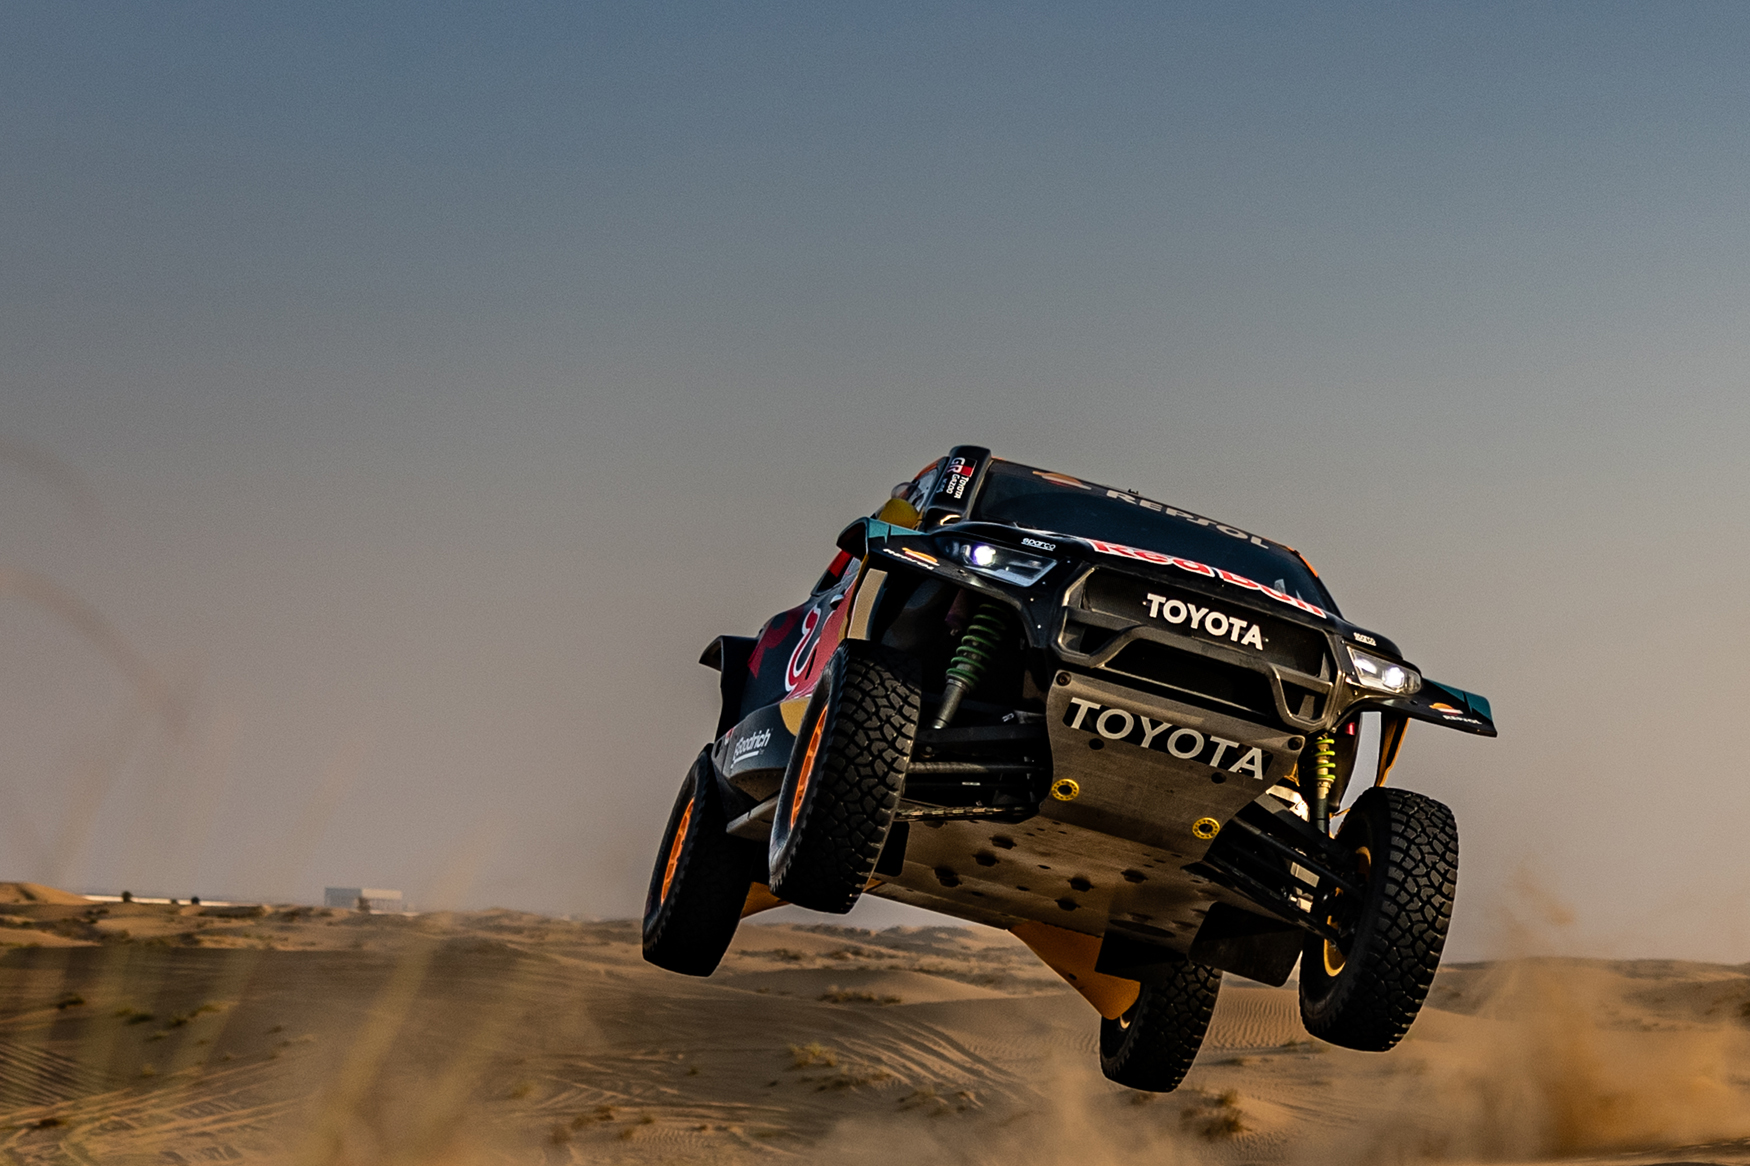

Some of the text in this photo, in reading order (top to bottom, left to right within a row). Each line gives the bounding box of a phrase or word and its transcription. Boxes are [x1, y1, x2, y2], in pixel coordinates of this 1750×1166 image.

[1021, 537, 1056, 551] sparco
[1106, 489, 1268, 549] REPSOL
[1147, 593, 1263, 650] TOYOTA
[1070, 697, 1263, 780] TOYOTA
